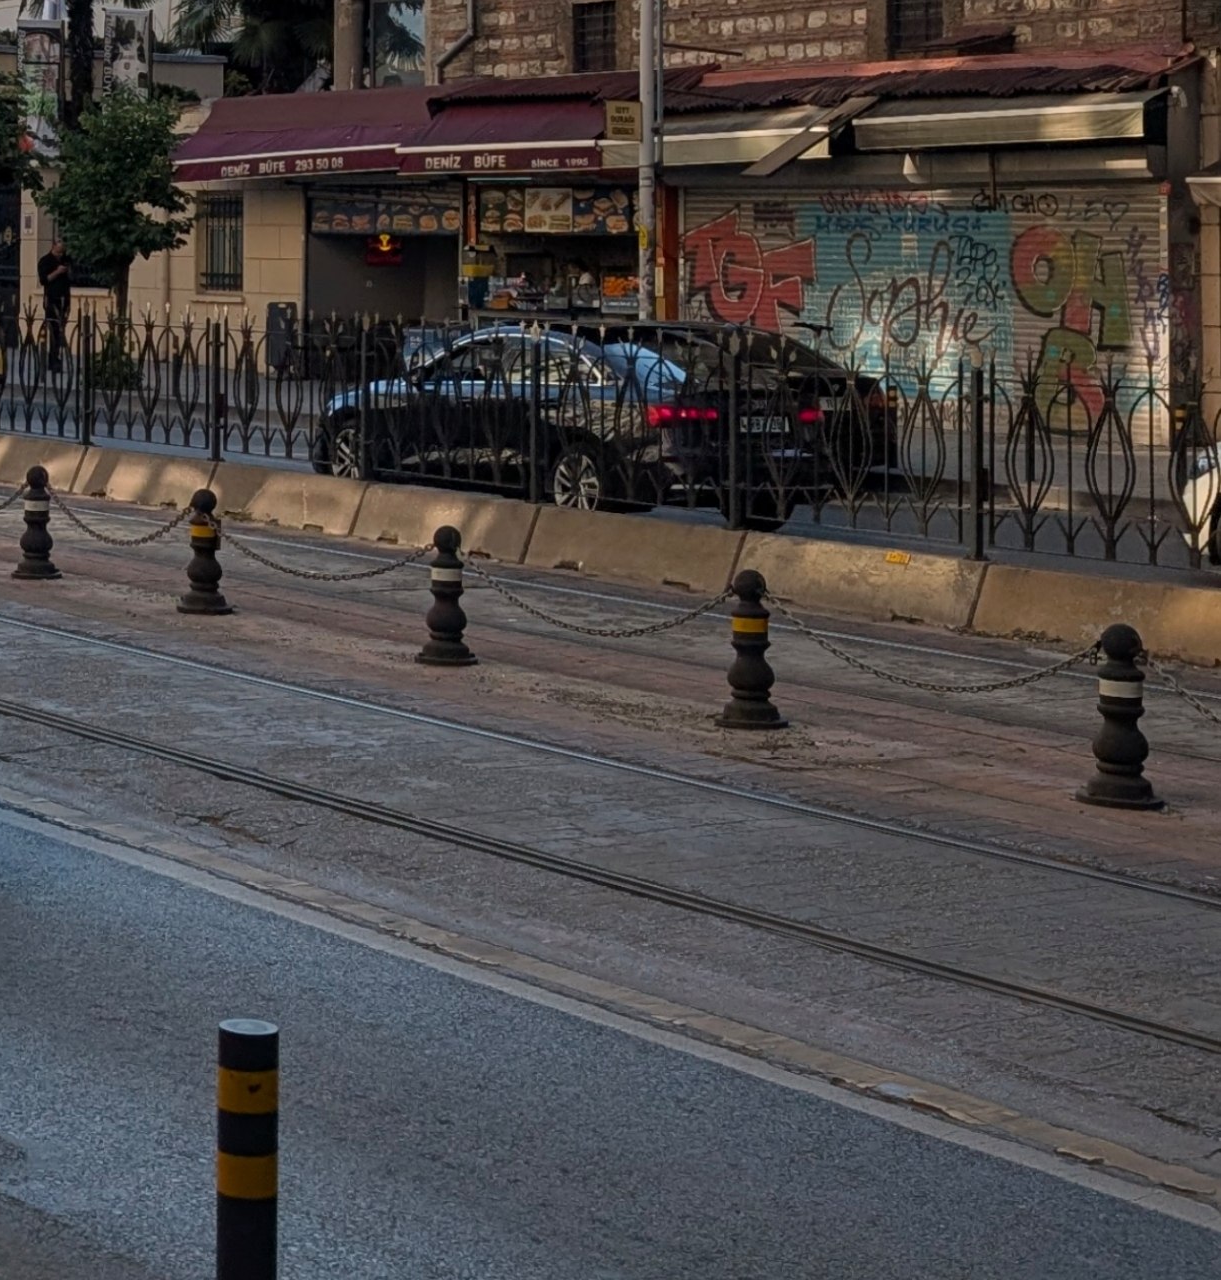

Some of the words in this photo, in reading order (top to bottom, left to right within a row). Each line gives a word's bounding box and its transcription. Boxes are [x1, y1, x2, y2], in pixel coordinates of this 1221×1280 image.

[221, 161, 250, 177] DENİZ
[259, 160, 286, 174] BÜFE
[295, 159, 314, 172] 293
[316, 158, 329, 170] 50
[331, 156, 344, 169] 08
[425, 154, 462, 169] DENİZ
[474, 153, 506, 168] BÜFE
[565, 157, 589, 167] 1995
